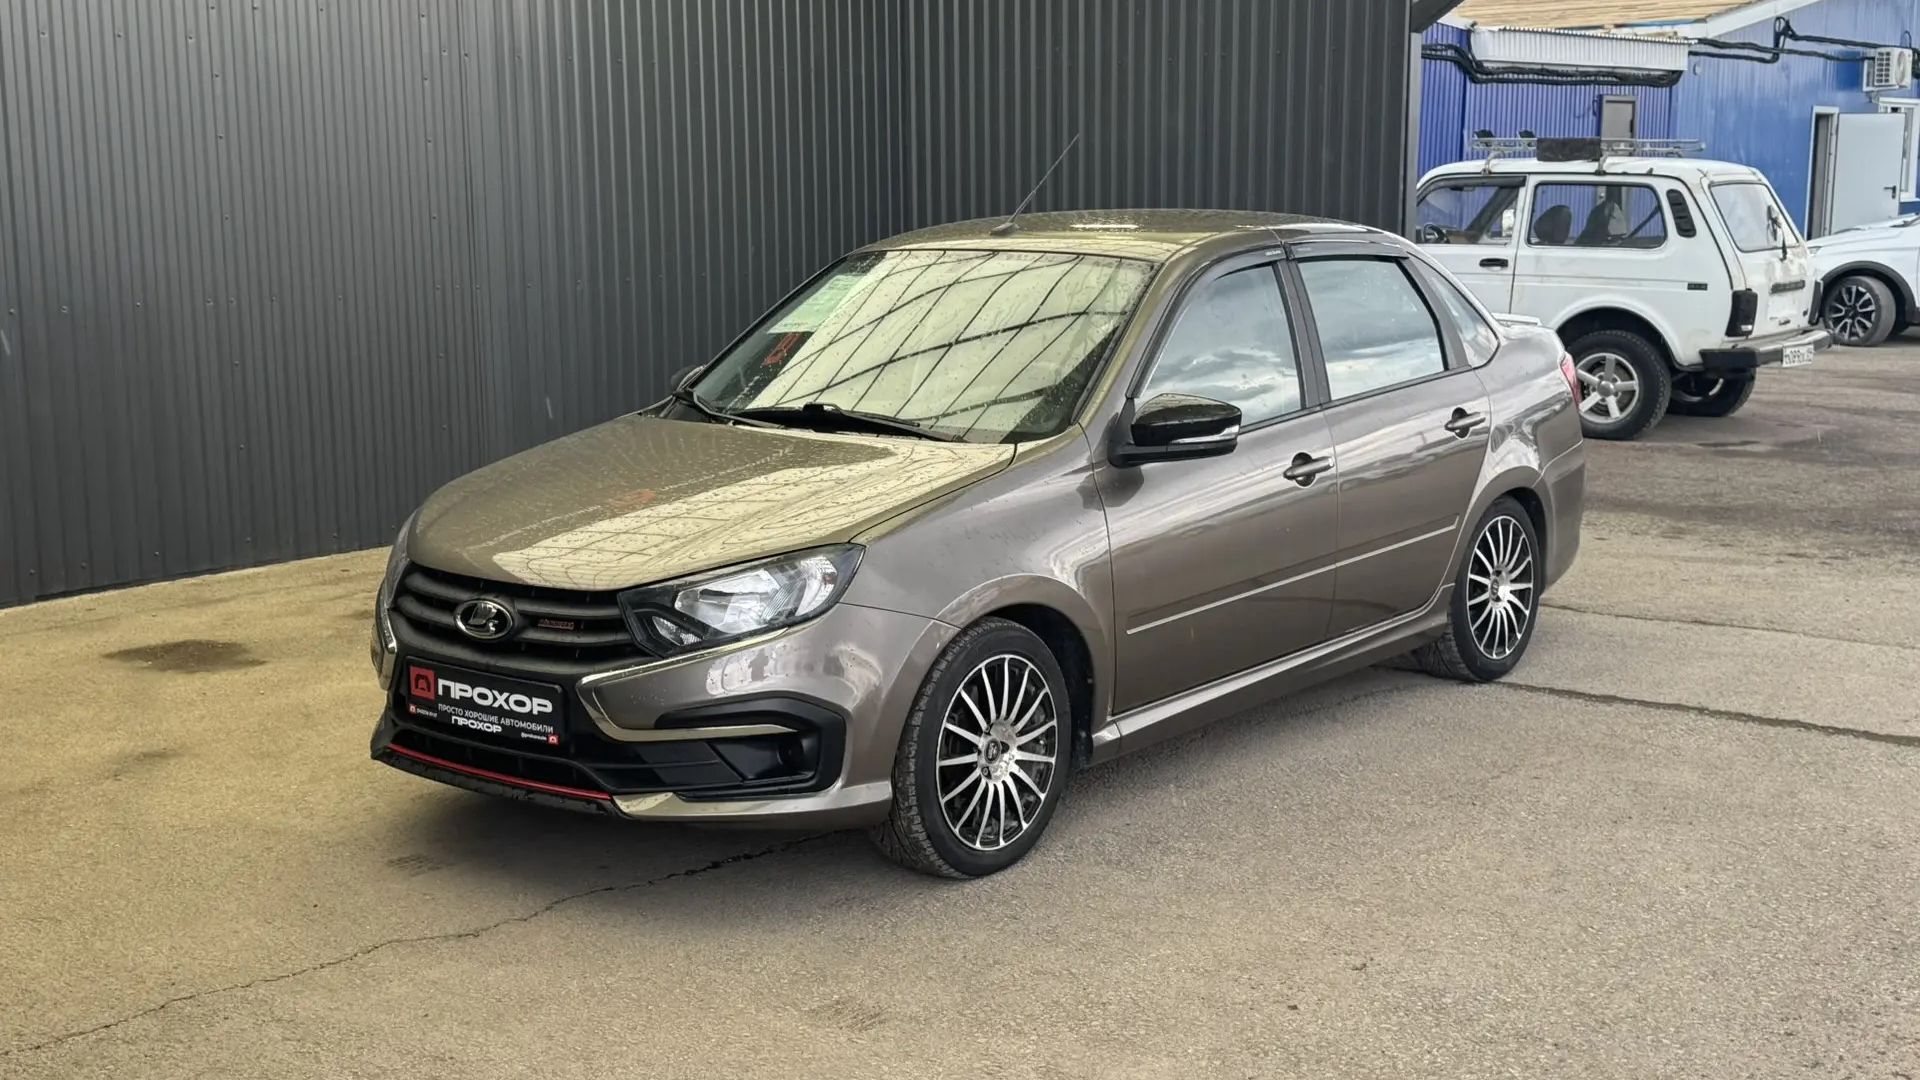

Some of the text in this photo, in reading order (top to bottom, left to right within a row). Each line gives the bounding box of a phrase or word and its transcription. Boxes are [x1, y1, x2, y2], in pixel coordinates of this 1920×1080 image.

[437, 678, 553, 715] ПРОХОР
[438, 703, 464, 717] ПРОСТО
[464, 709, 500, 725] ХОРОШИЕ
[500, 717, 554, 733] АВТОМОБИЛИ
[451, 715, 503, 733] ПРОХОР
